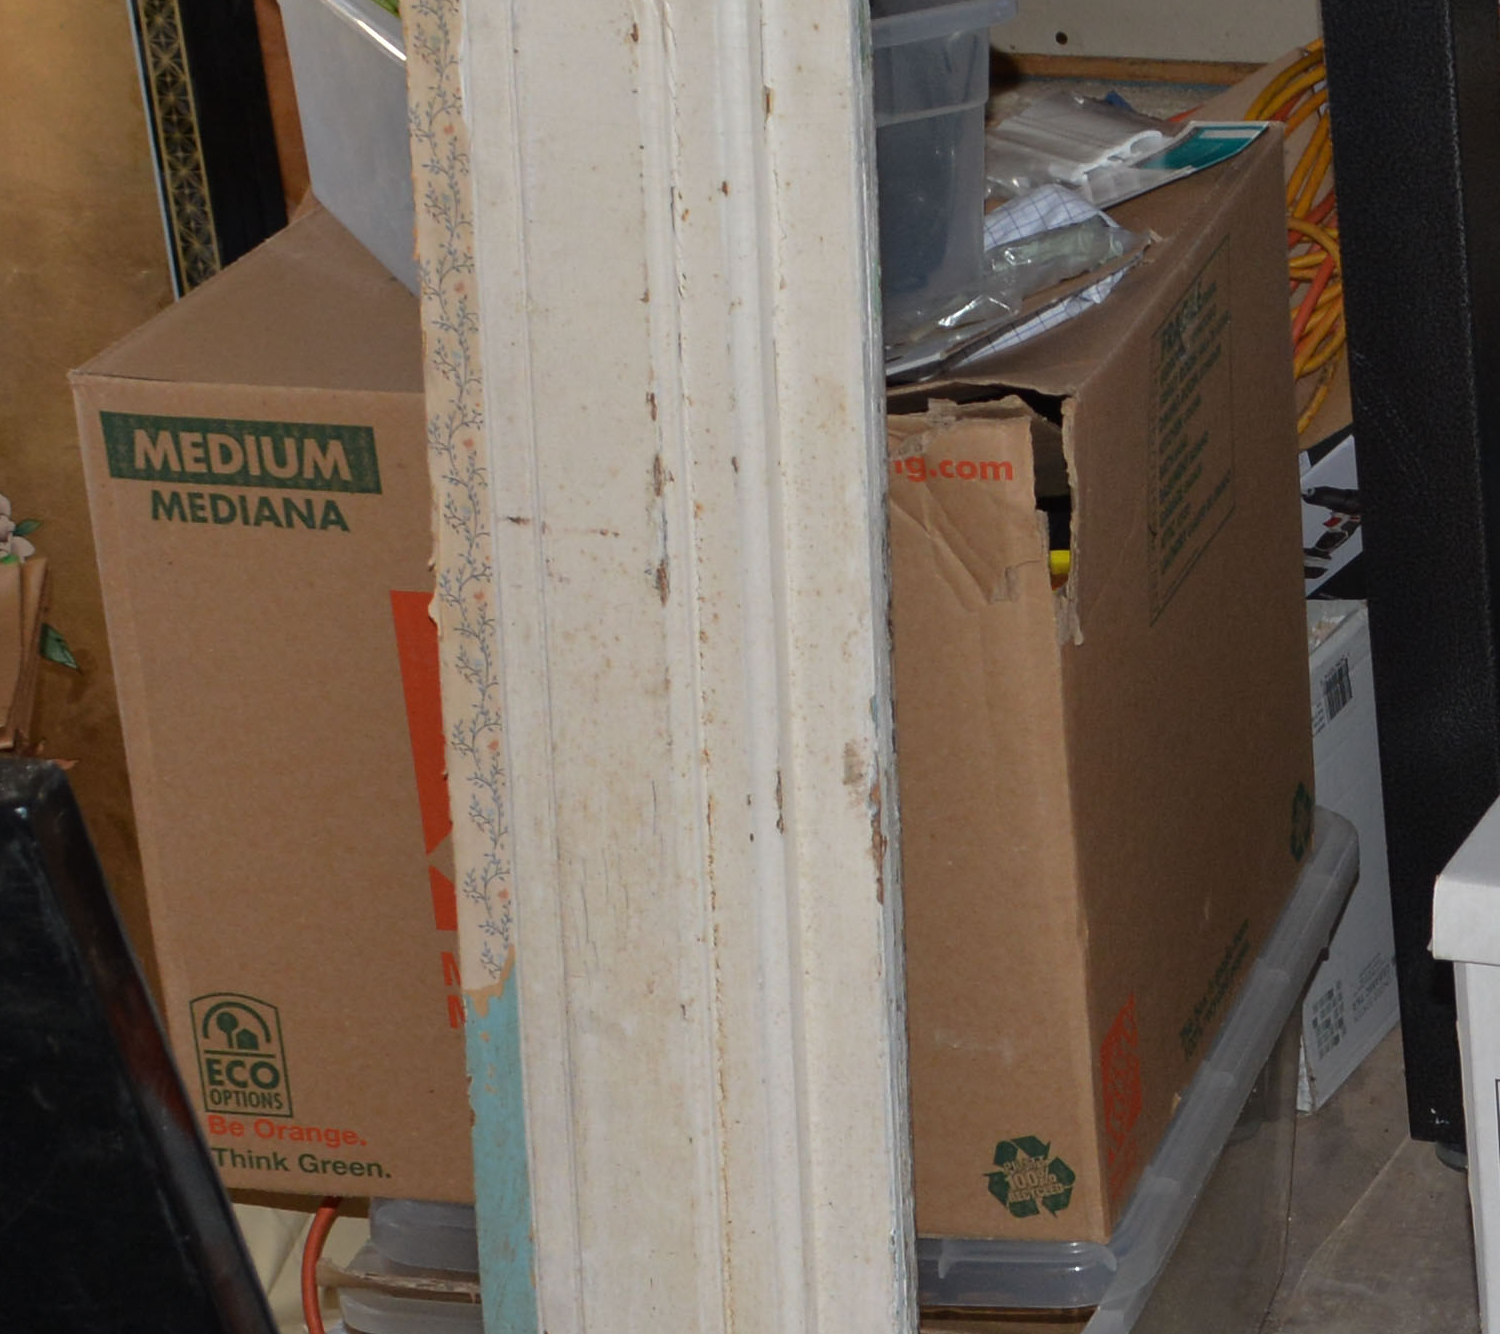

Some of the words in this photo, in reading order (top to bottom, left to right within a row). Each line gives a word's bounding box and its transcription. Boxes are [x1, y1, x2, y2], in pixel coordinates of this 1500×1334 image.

[133, 428, 352, 481] MEDIUM
[151, 489, 350, 532] MEDIANA
[205, 1058, 281, 1090] ECO
[209, 1088, 283, 1110] OPTIONS
[208, 1114, 245, 1137] Be
[254, 1118, 368, 1149] Orange.
[211, 1147, 290, 1172] Think
[298, 1153, 392, 1179] Green.
